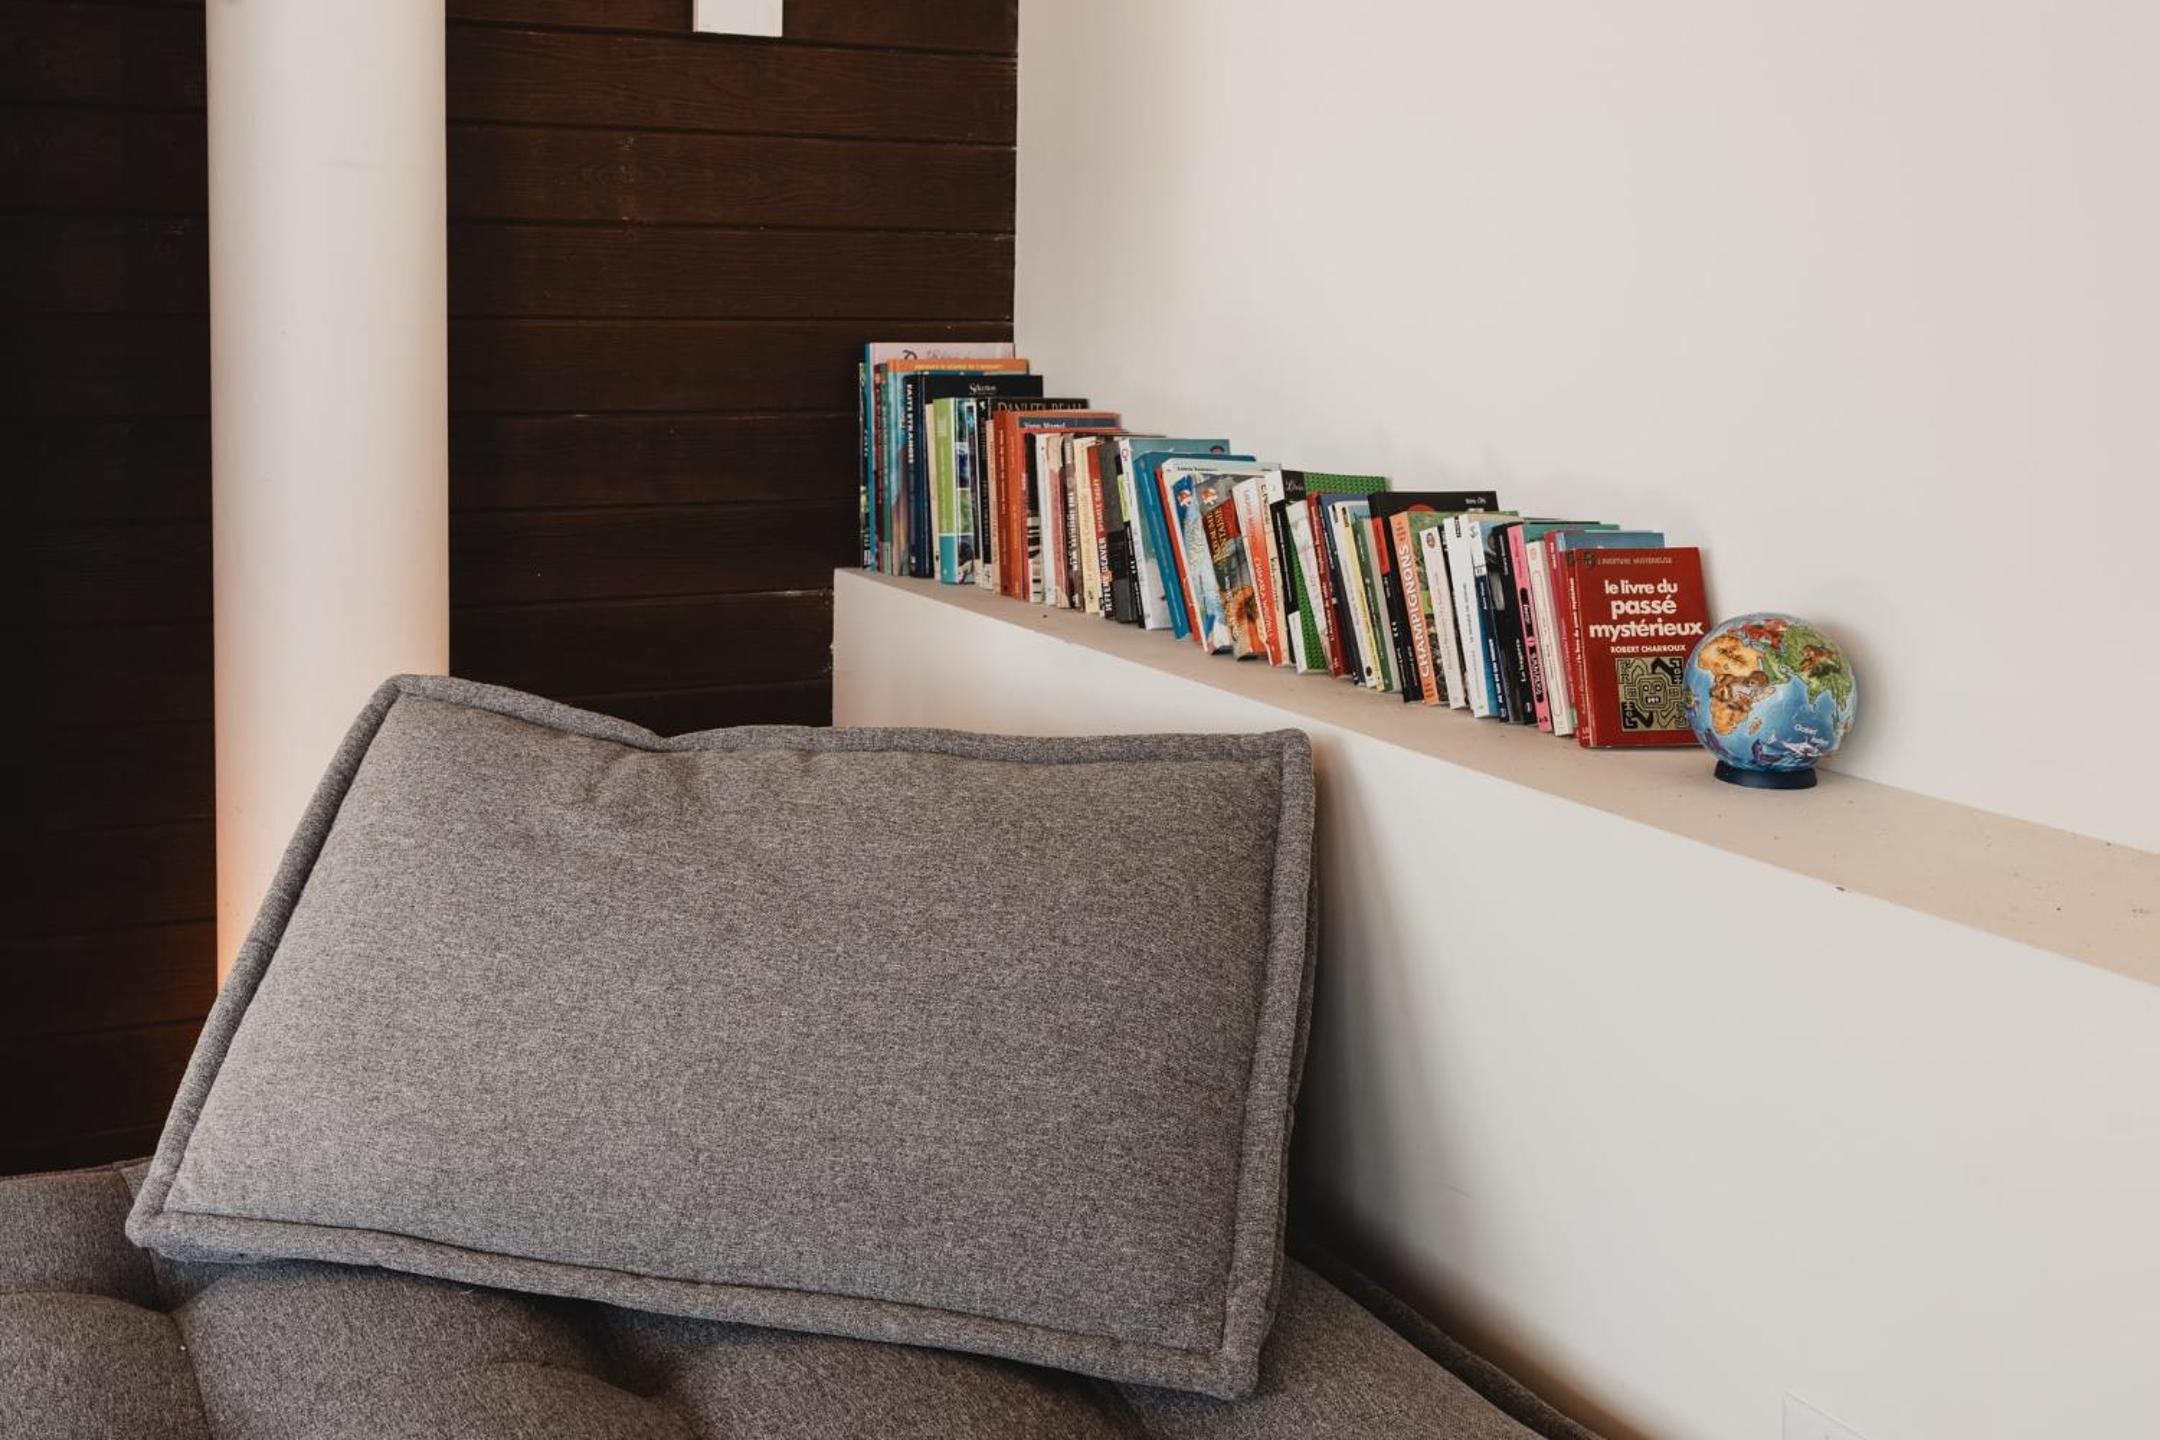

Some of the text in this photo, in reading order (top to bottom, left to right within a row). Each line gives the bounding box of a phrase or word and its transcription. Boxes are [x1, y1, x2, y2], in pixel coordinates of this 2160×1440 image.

[906, 383, 914, 411] FAITS
[1098, 536, 1109, 572] DEAVER
[1604, 578, 1678, 594] le livre du
[1399, 543, 1430, 678] CHAMPIGNONS
[1610, 594, 1677, 620] passé
[1589, 617, 1704, 642] mystérieux
[1641, 644, 1686, 653] CHARROUX
